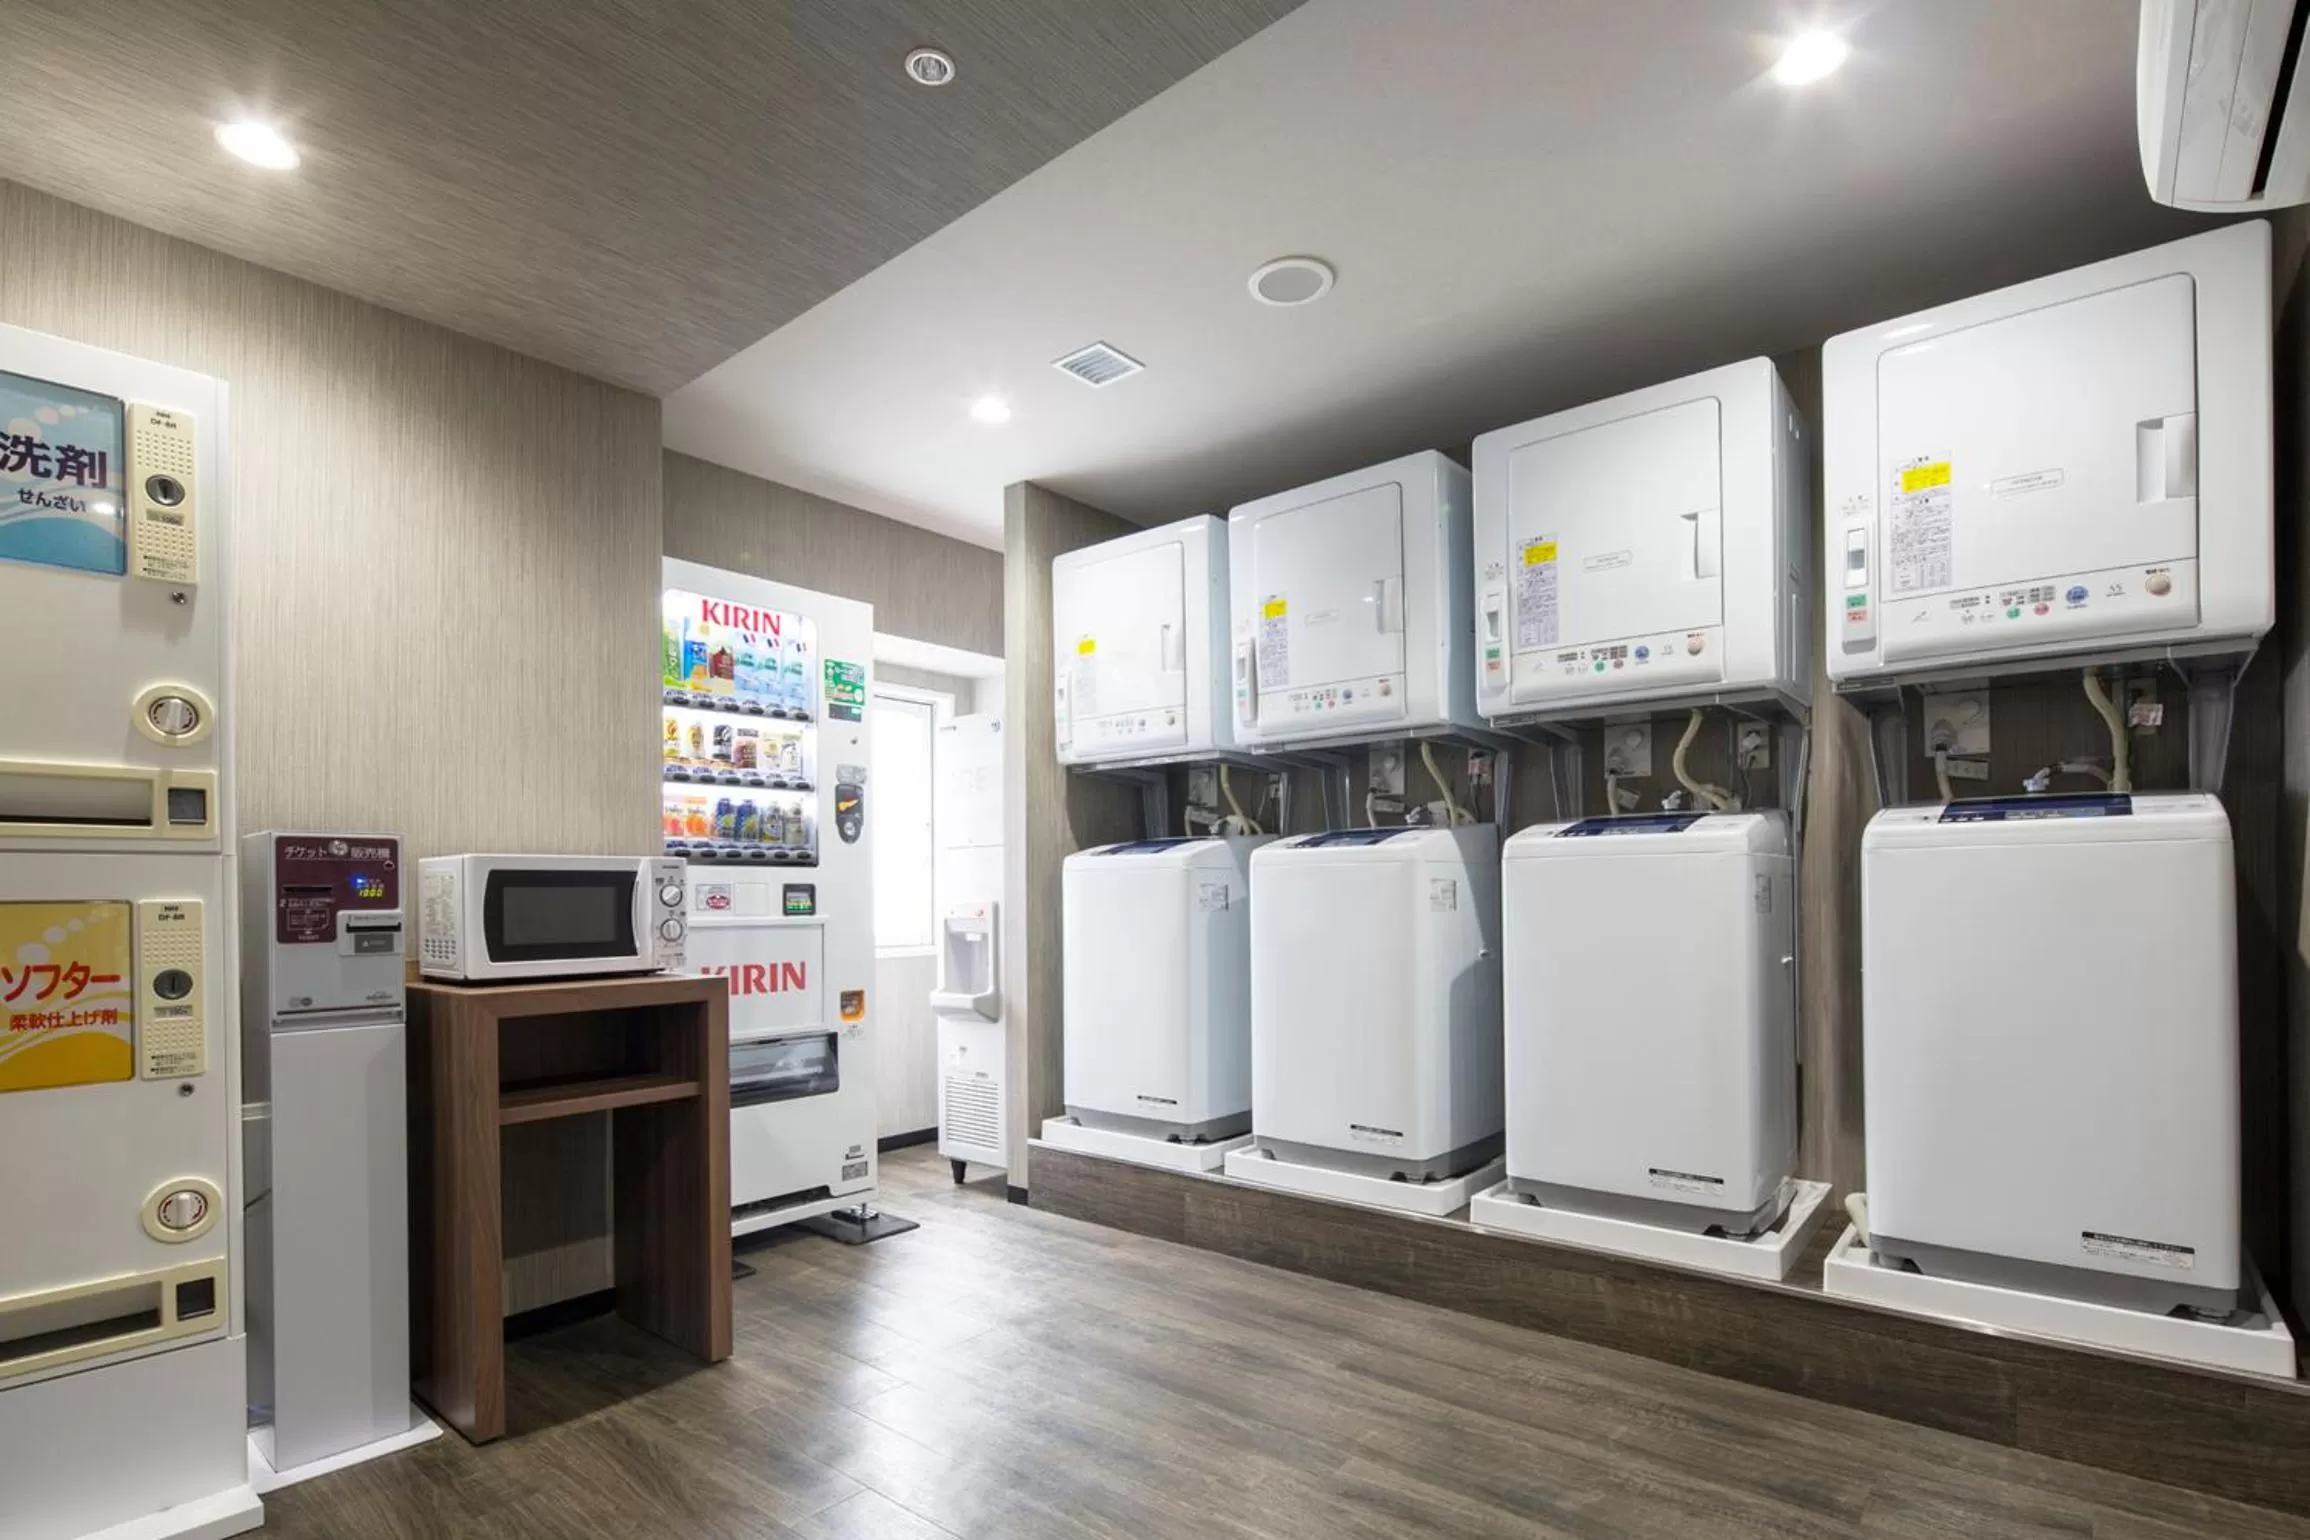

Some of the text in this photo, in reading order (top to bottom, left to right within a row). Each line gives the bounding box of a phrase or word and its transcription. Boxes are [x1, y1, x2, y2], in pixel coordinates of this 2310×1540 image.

[0, 432, 107, 488] 洗剤
[17, 488, 86, 512] せんざい
[702, 599, 780, 635] KIRIN
[1, 961, 121, 1001] ソフター
[10, 1008, 119, 1032] 柔軟仕上げ剤
